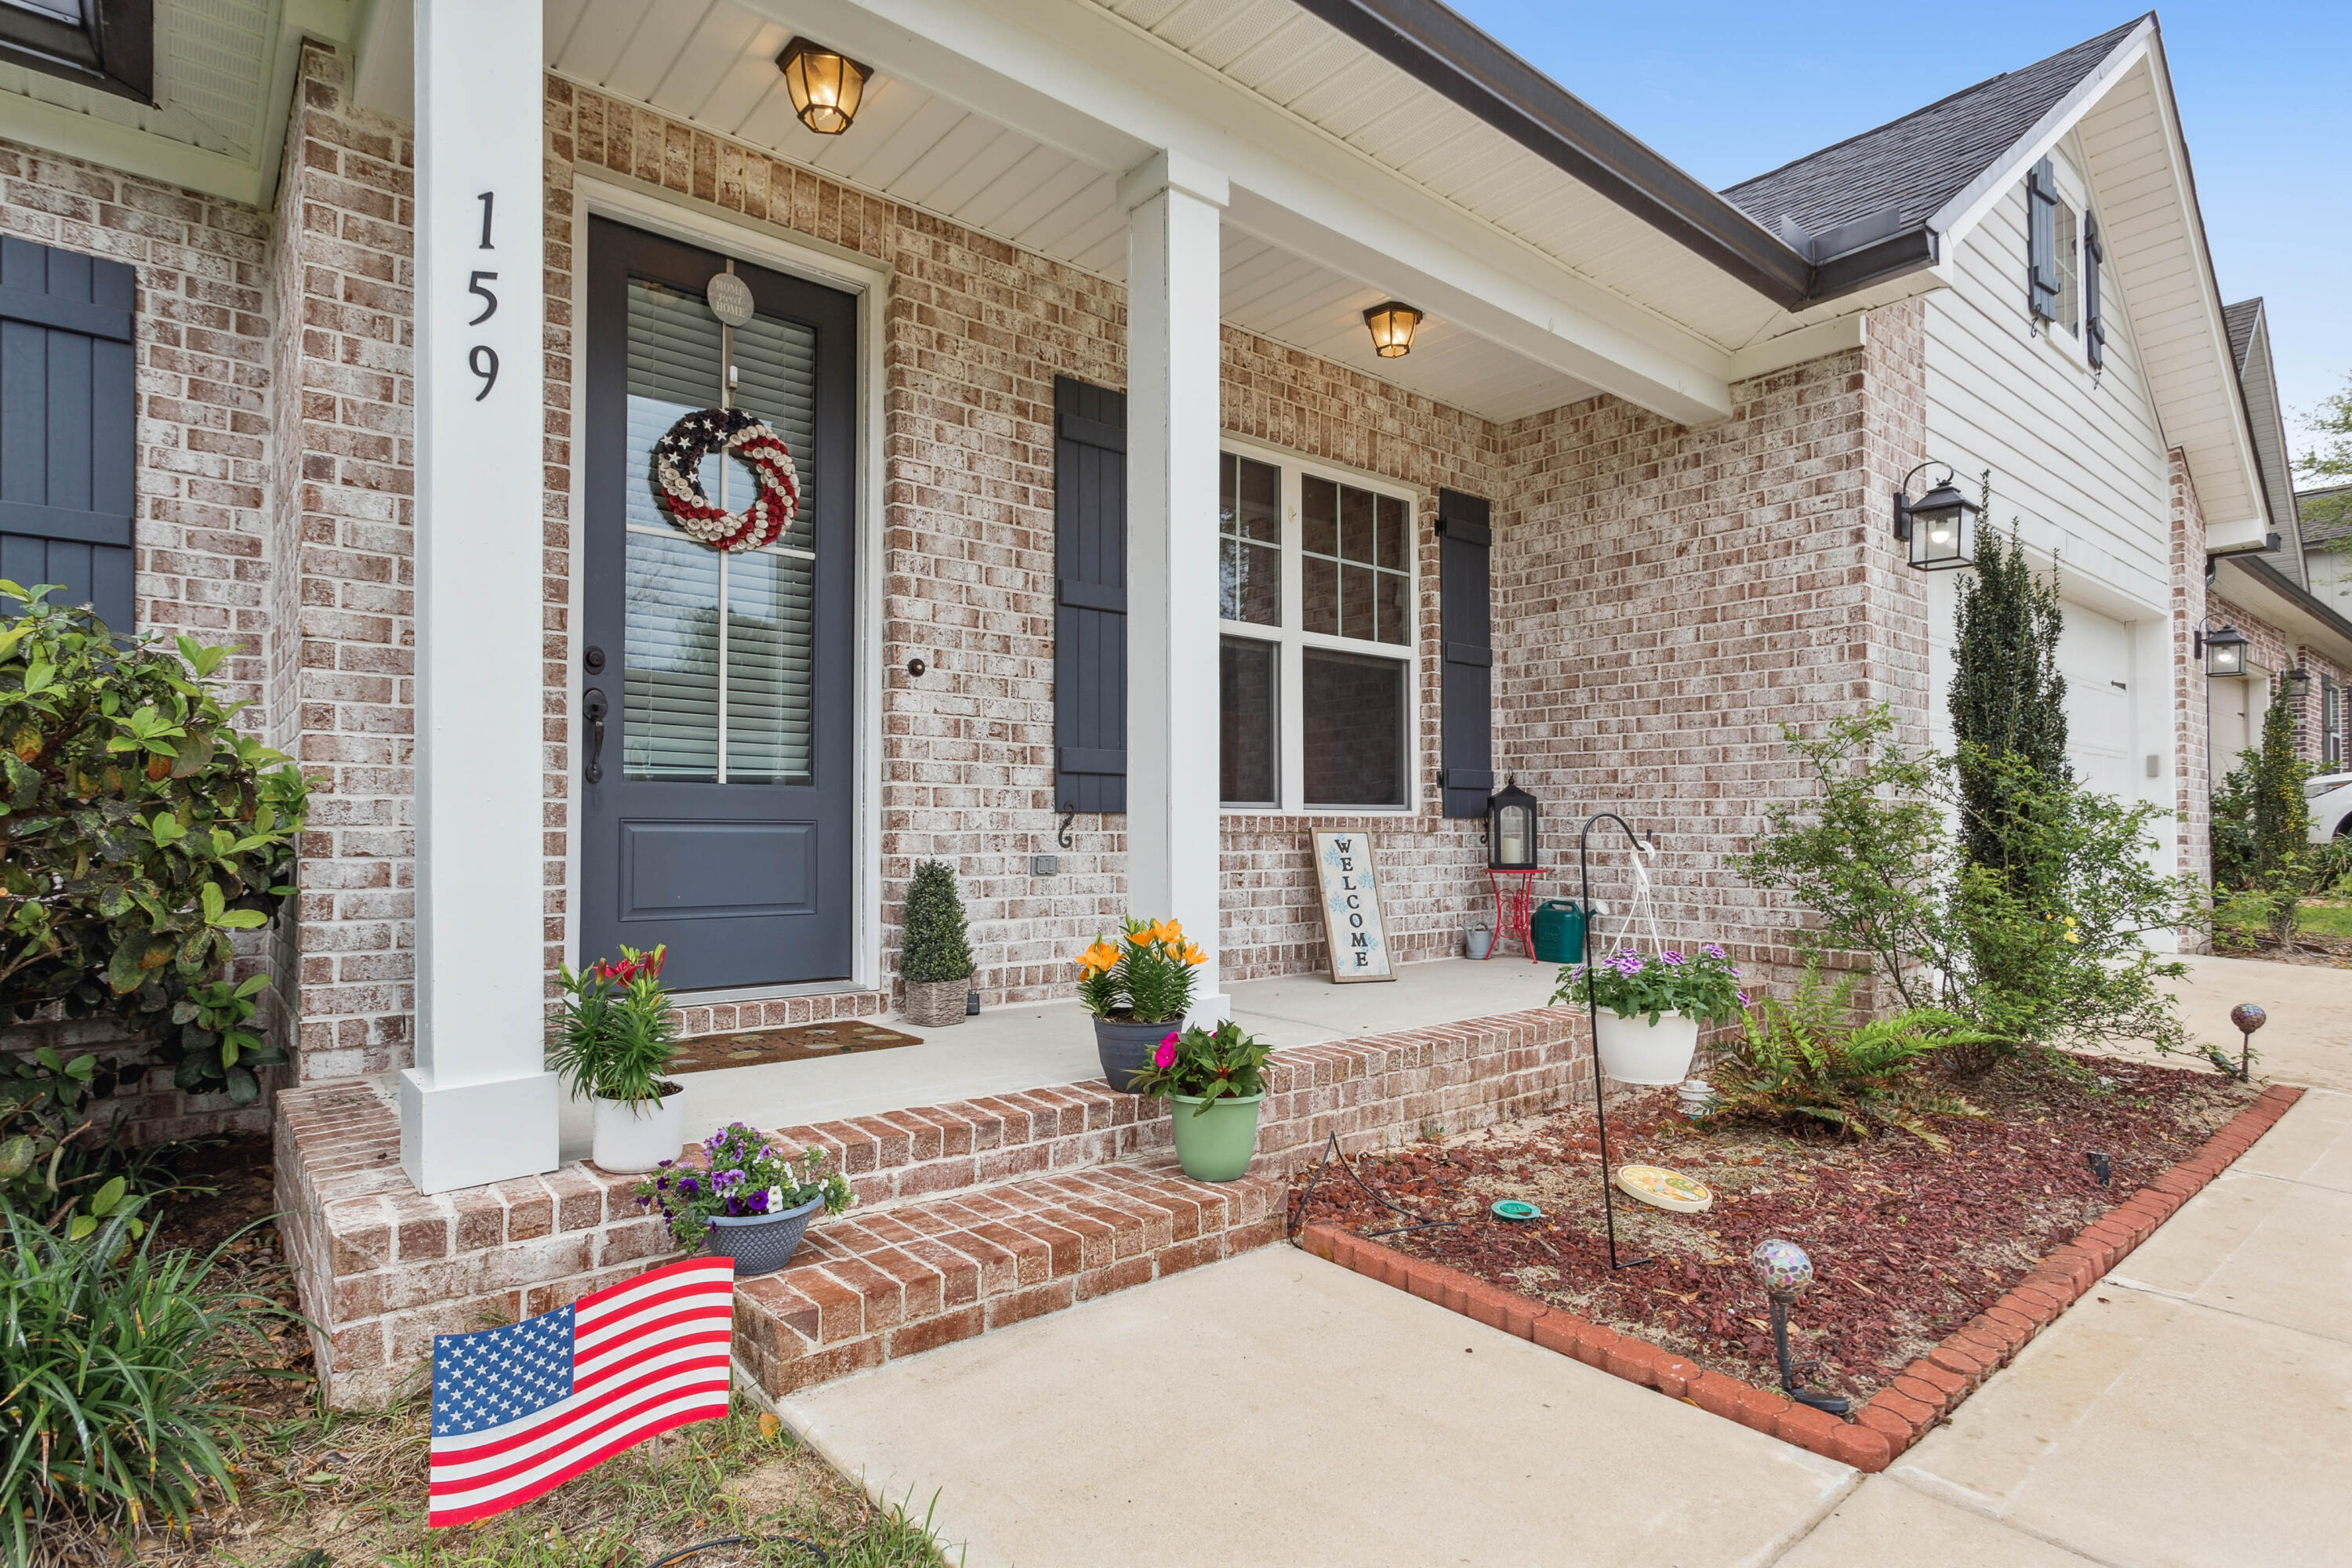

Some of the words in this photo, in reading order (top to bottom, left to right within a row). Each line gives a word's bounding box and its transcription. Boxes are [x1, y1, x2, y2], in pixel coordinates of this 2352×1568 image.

[468, 191, 499, 401] 159
[716, 281, 745, 296] HOME
[716, 301, 746, 318] HOME
[1334, 839, 1369, 967] WELCOME
